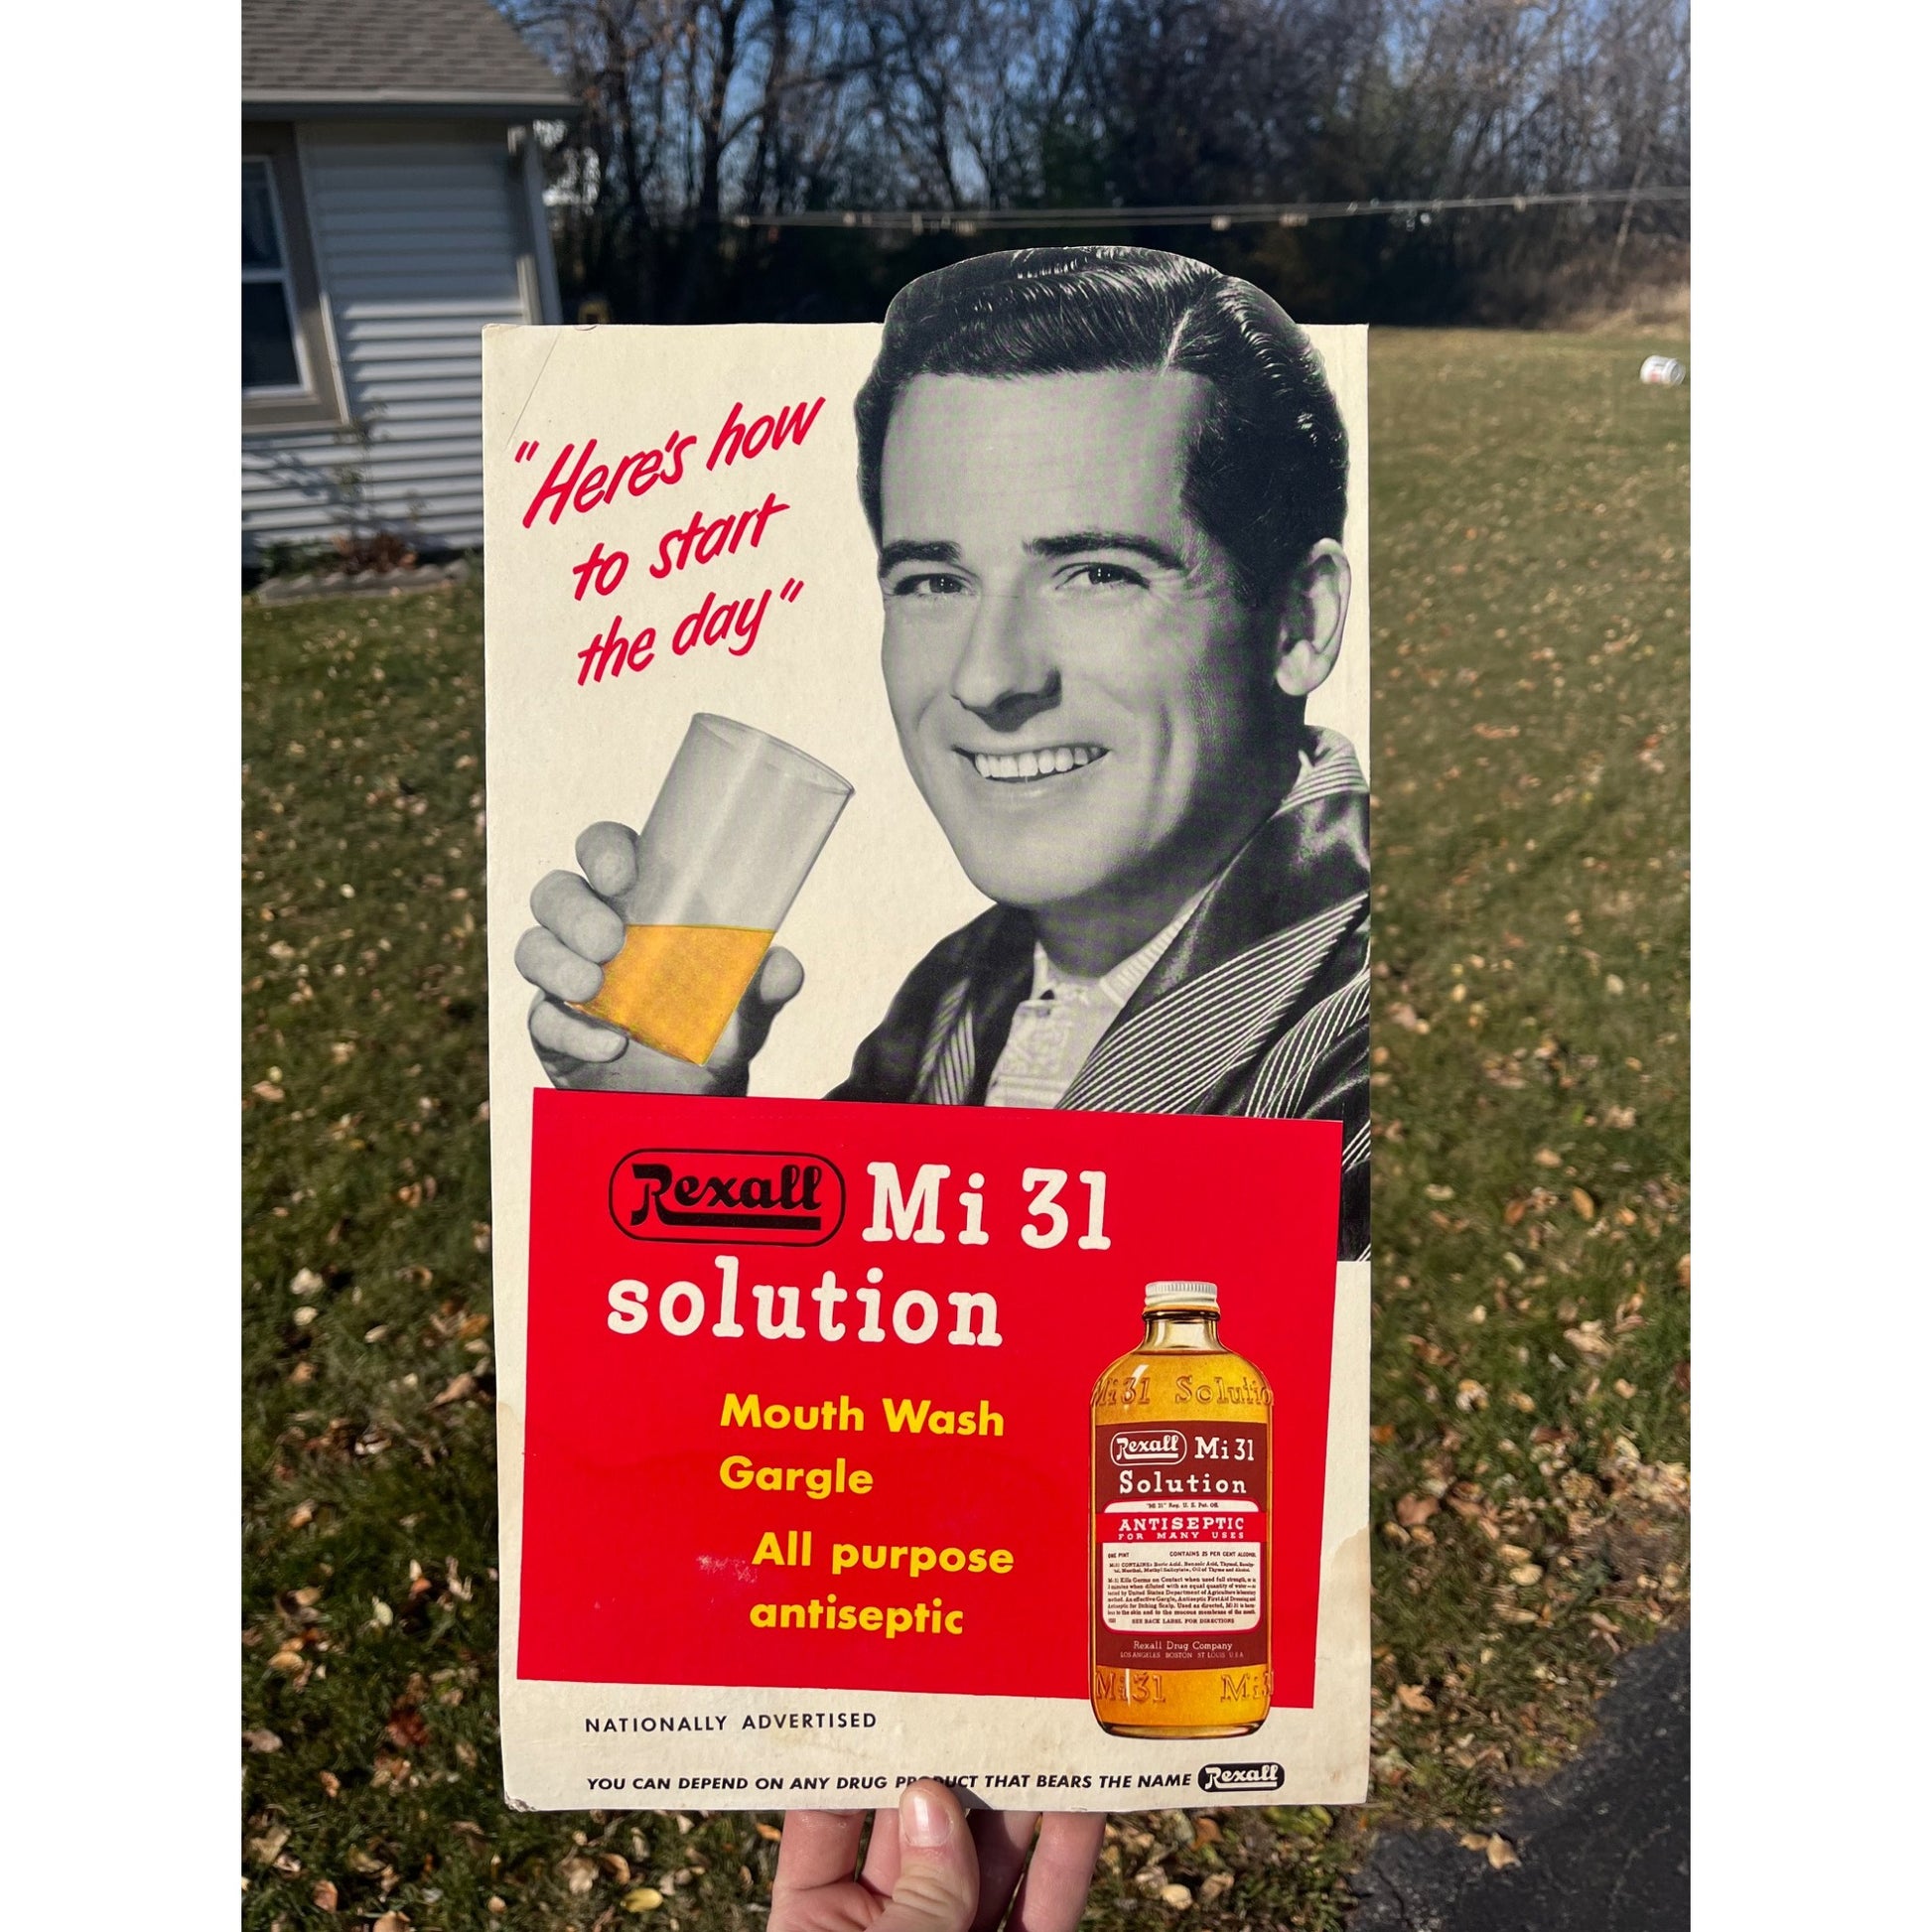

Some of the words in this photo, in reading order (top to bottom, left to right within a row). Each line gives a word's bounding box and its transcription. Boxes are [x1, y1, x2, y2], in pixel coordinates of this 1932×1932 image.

[514, 429, 698, 529] "Here's
[706, 396, 826, 471] how
[572, 542, 629, 601] to
[649, 492, 790, 579] start
[577, 615, 656, 686] the
[672, 577, 804, 656] day"
[630, 1162, 823, 1231] Rexall
[862, 1162, 990, 1246] Mi
[1020, 1167, 1112, 1251] 31
[607, 1255, 1003, 1347] solution
[719, 1393, 865, 1432] Mouth
[882, 1397, 1005, 1437] Wash
[1116, 1435, 1179, 1461] Rexall
[1194, 1436, 1230, 1459] Mi
[1234, 1439, 1254, 1461] 31
[718, 1454, 875, 1499] Gargle
[1119, 1469, 1247, 1494] Solution
[1118, 1516, 1244, 1531] ANTISEPTIC
[752, 1530, 812, 1566] All
[832, 1538, 1015, 1578] purpose
[749, 1594, 964, 1639] antiseptic
[1133, 1640, 1163, 1650] Rexall
[1167, 1640, 1189, 1652] Drug
[1191, 1640, 1233, 1651] Company
[585, 1716, 728, 1732] NATIONALLY
[742, 1713, 878, 1730] ADVERTISED
[587, 1777, 625, 1790] YOU
[631, 1777, 671, 1790] CAN
[677, 1777, 749, 1790] DEPEND
[755, 1777, 784, 1790] ON
[789, 1776, 830, 1790] ANY
[836, 1776, 888, 1790] DRUG
[984, 1775, 1031, 1788] THAT
[1035, 1775, 1092, 1788] BEARS
[1099, 1774, 1132, 1788] THE
[1137, 1773, 1192, 1788] NAME
[1204, 1764, 1279, 1790] Rexall
